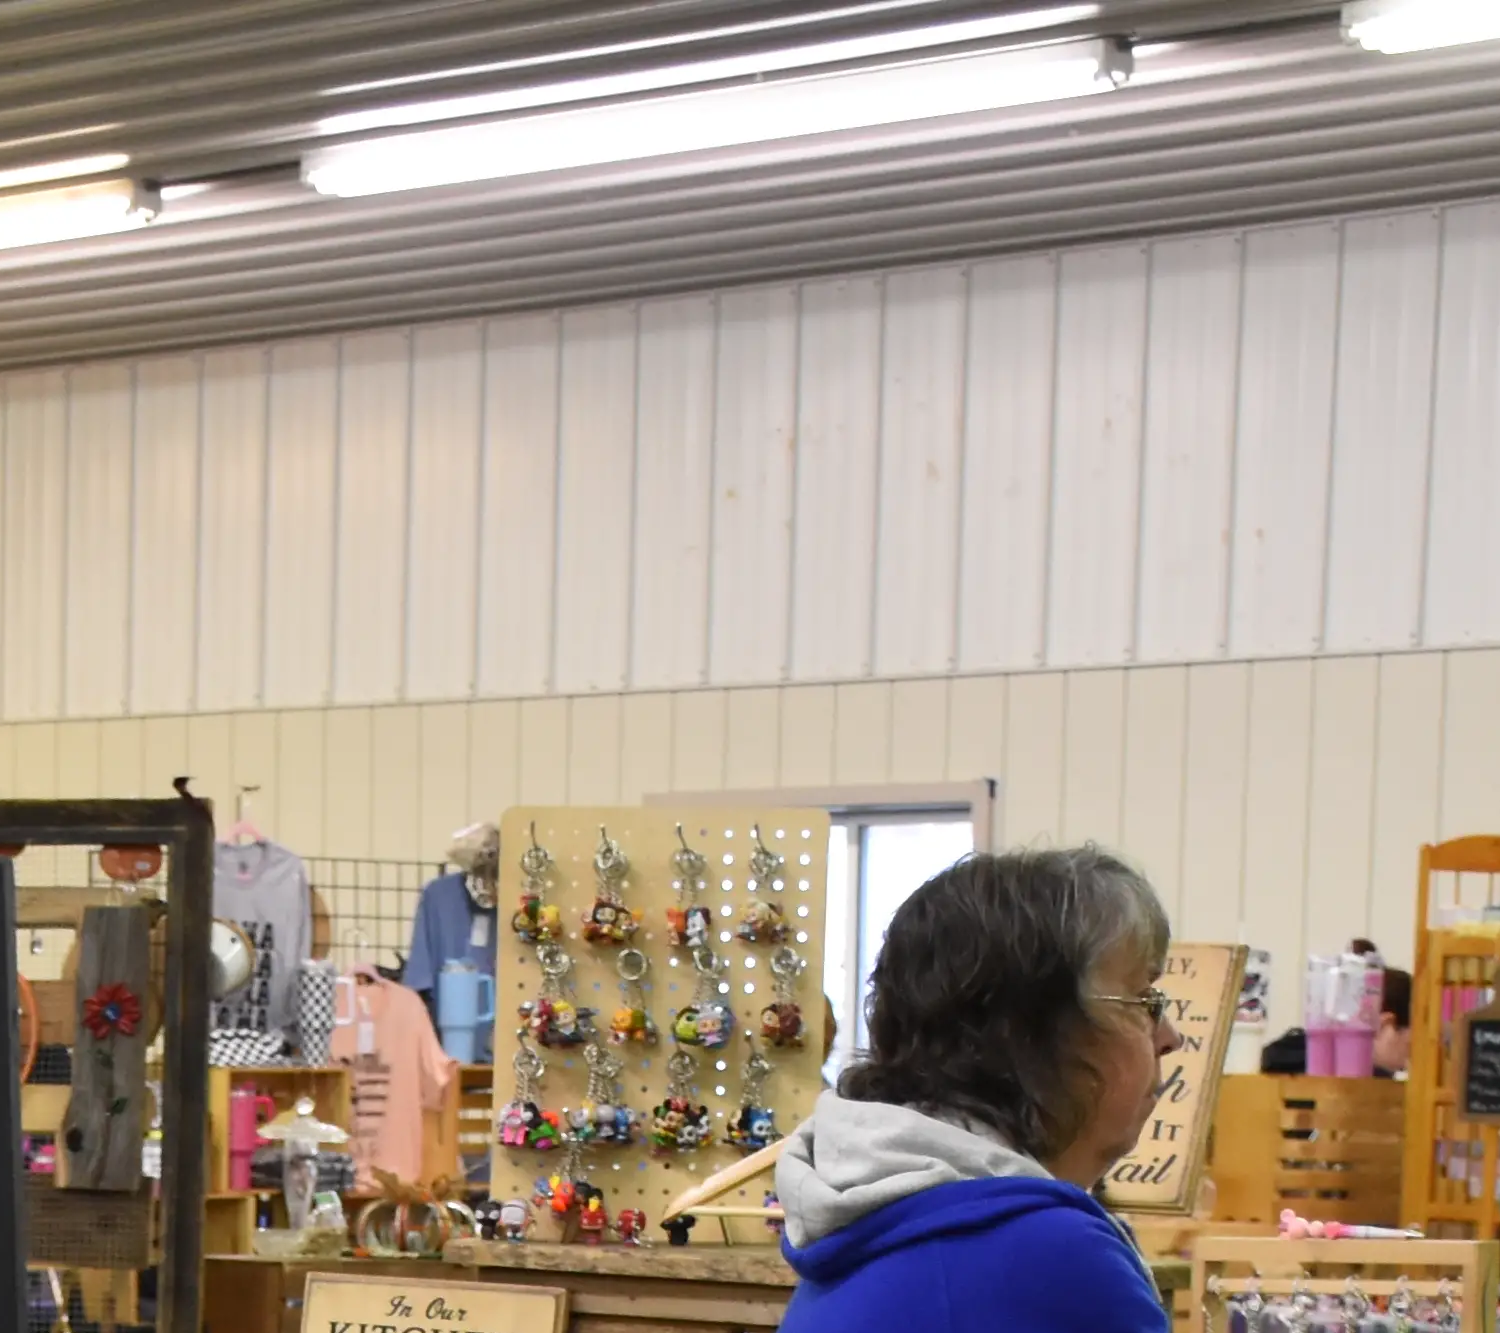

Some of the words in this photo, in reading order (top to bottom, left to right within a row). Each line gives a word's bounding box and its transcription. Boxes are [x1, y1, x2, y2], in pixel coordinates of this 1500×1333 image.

[1109, 1153, 1177, 1185] ail
[384, 1295, 413, 1318] In
[425, 1297, 469, 1323] Our
